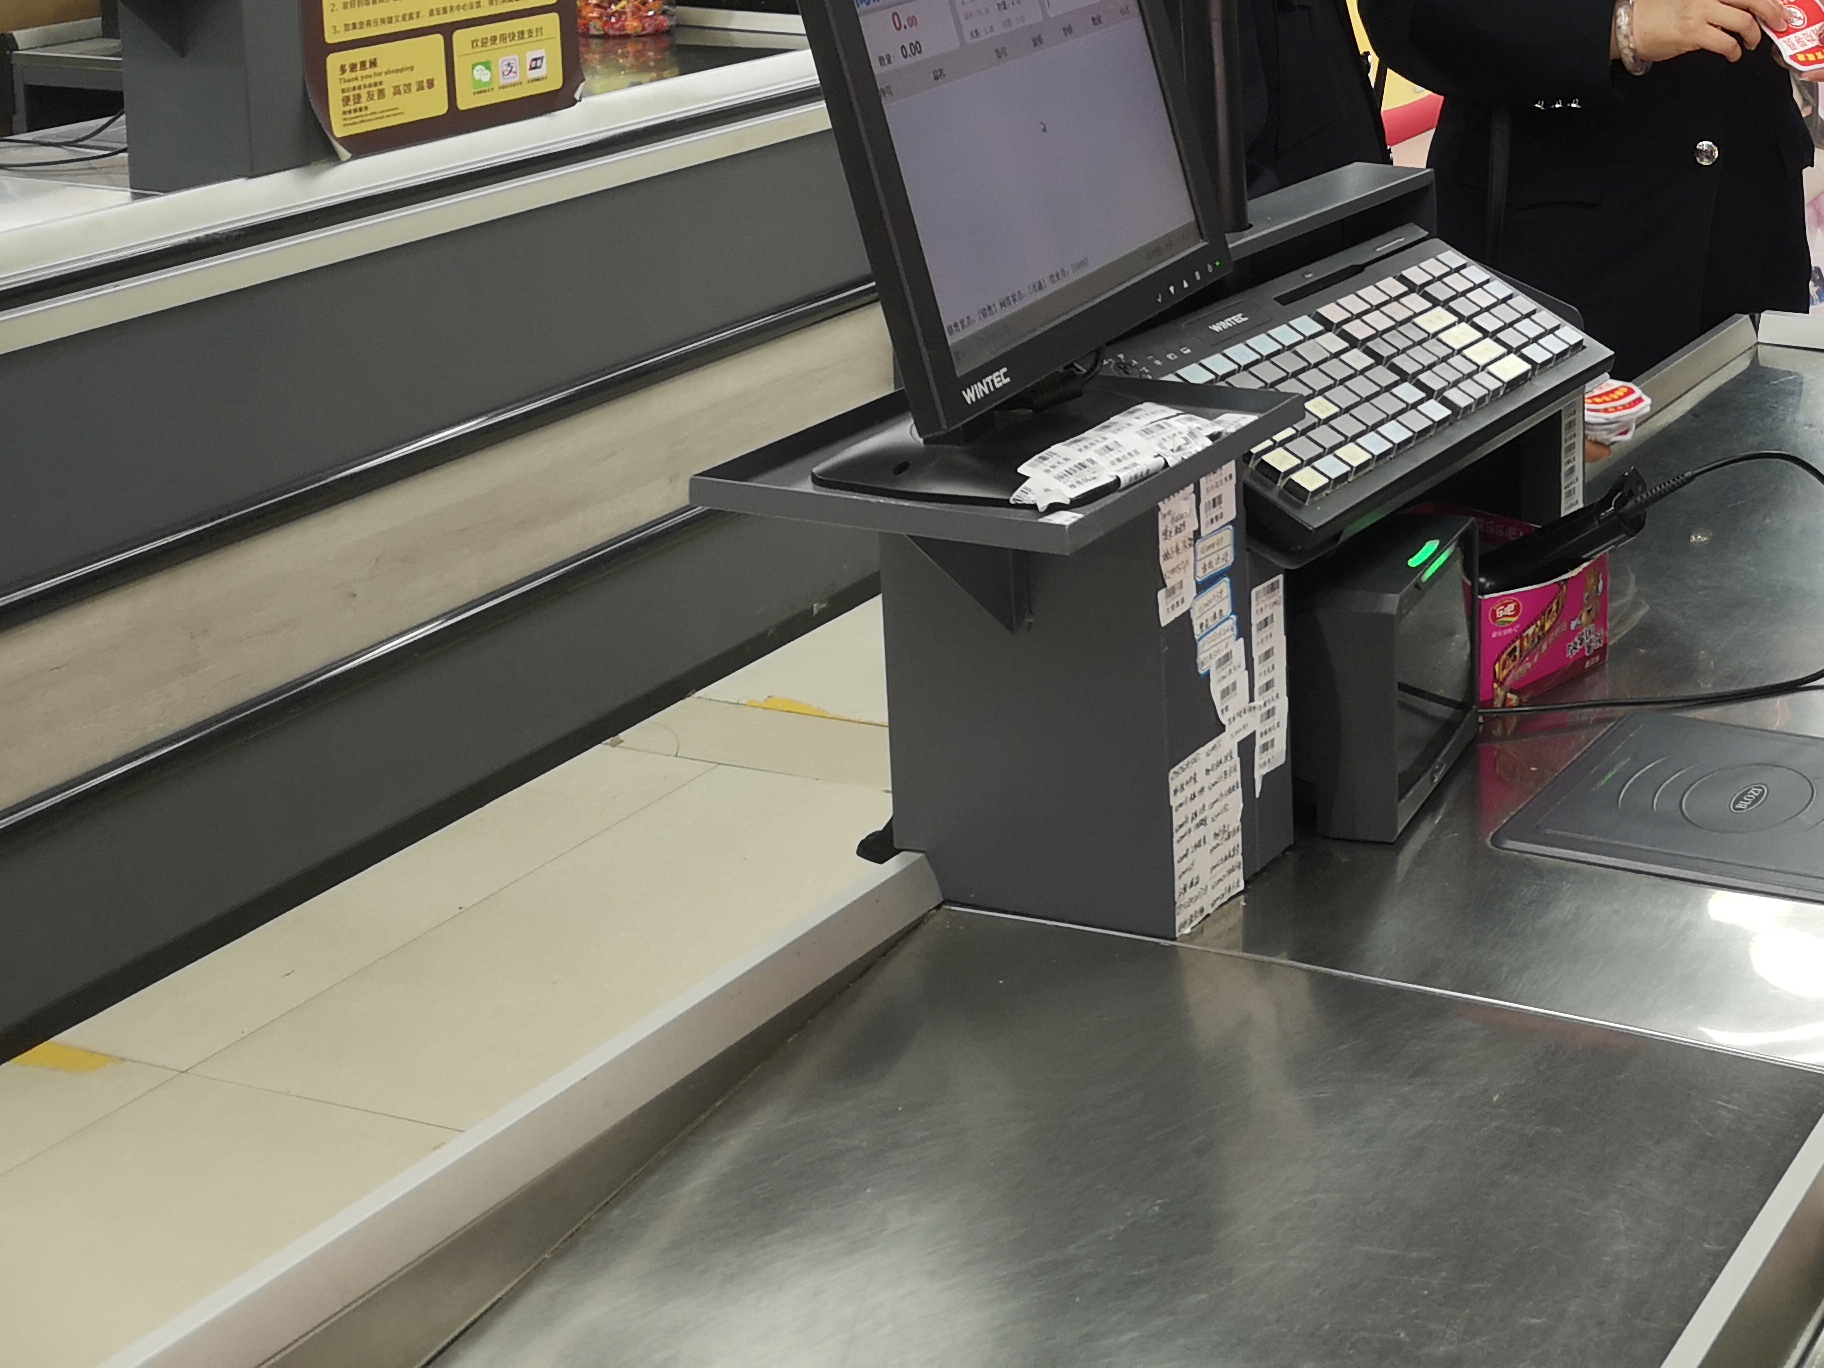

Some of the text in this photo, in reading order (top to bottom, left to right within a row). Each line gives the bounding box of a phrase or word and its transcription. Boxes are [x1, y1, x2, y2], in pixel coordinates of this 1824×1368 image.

[891, 11, 918, 33] 0.00
[470, 26, 544, 50] 欢迎使用快捷支付
[900, 40, 923, 61] 0.00
[338, 57, 379, 76] 多谢惠顾
[338, 64, 414, 85] Thank you for shopping
[341, 77, 436, 108] 便捷 友善 高效 温馨
[1208, 312, 1250, 334] WINTEC
[962, 367, 1011, 406] WINTEC
